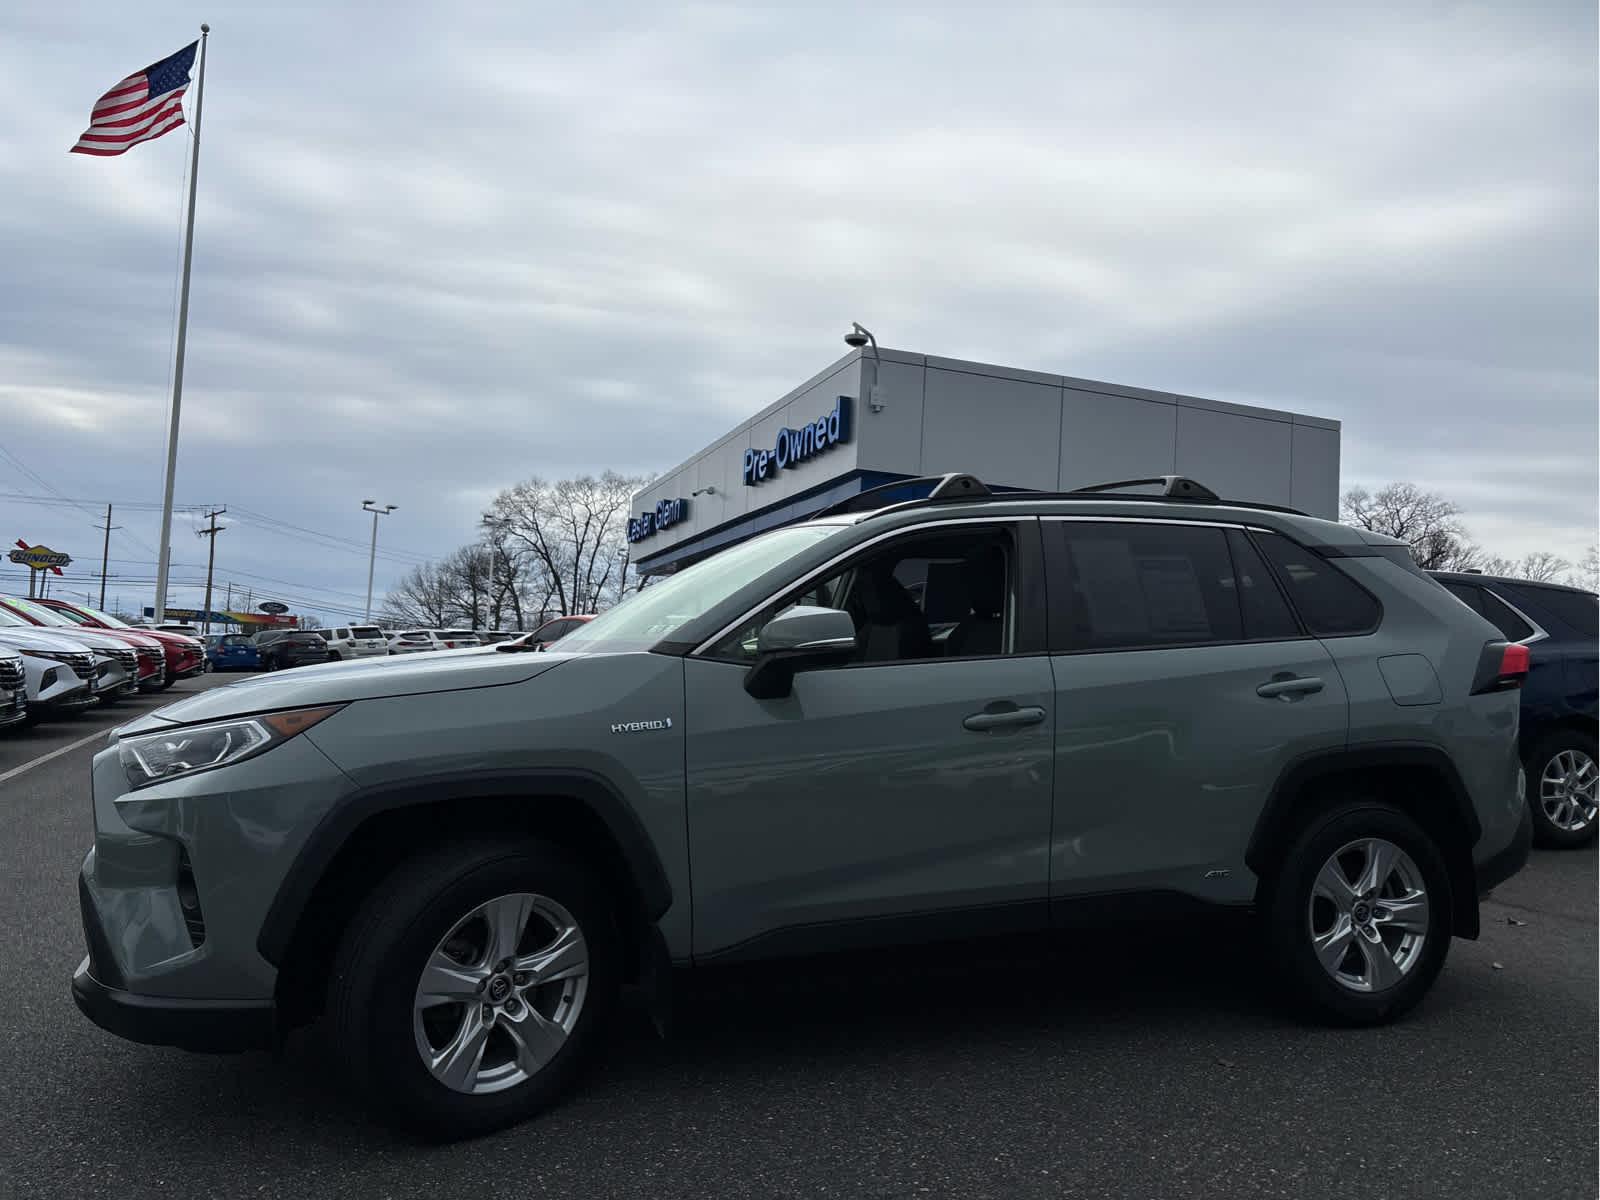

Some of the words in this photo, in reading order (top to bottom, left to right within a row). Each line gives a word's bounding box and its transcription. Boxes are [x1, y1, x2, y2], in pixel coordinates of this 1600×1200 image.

[743, 396, 846, 486] Pre-Owned
[655, 498, 684, 530] Glenn
[14, 551, 67, 563] SUNOCO
[611, 720, 663, 733] HYBRID
